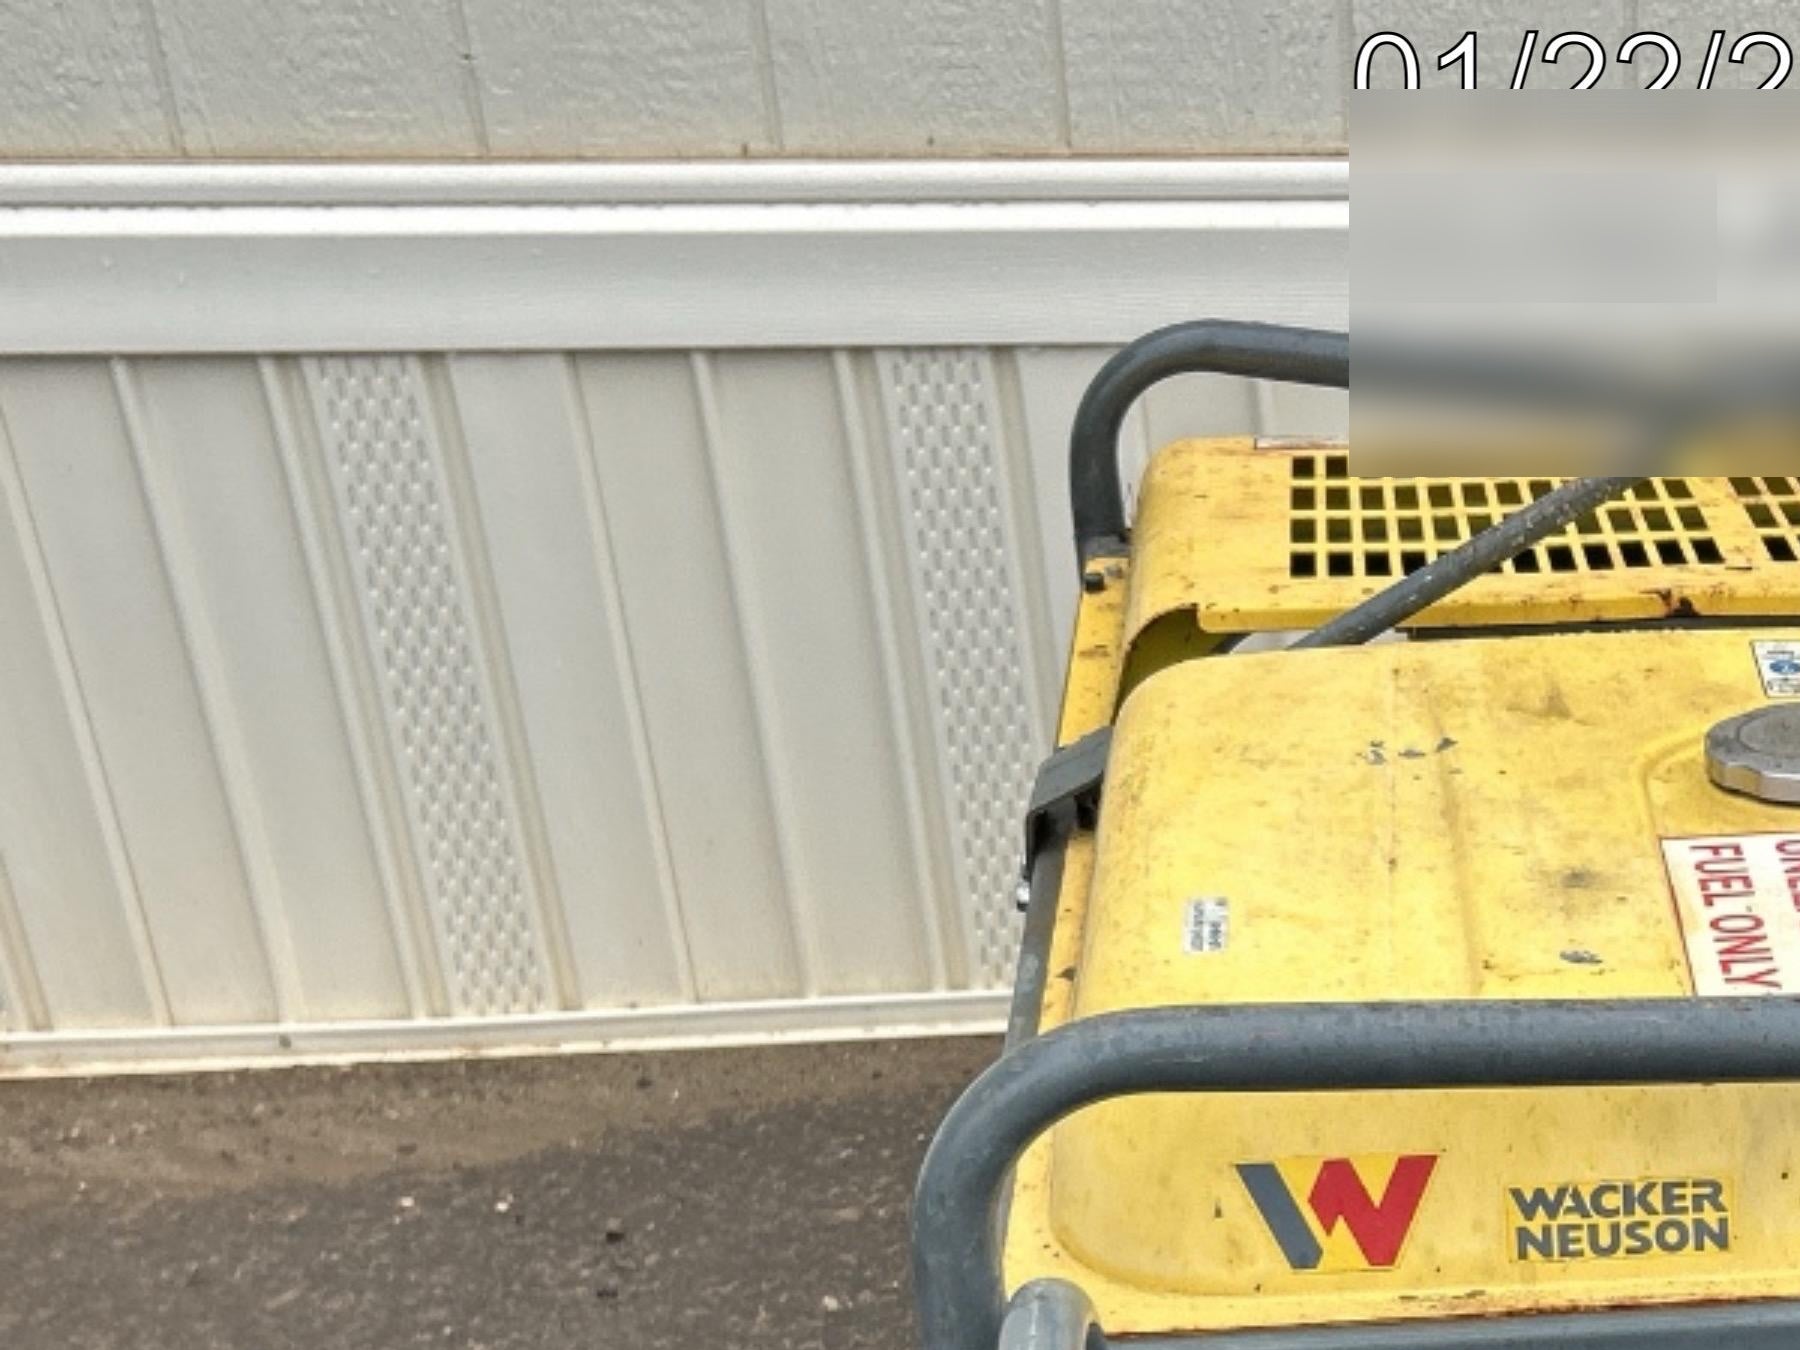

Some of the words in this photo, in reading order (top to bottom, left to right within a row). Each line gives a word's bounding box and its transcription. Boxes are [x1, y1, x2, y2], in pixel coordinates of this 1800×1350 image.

[1689, 843, 1755, 907] FUEL
[1709, 914, 1783, 990] ONLY
[1508, 1179, 1728, 1222] WACKER
[1516, 1217, 1729, 1261] NEUSON
